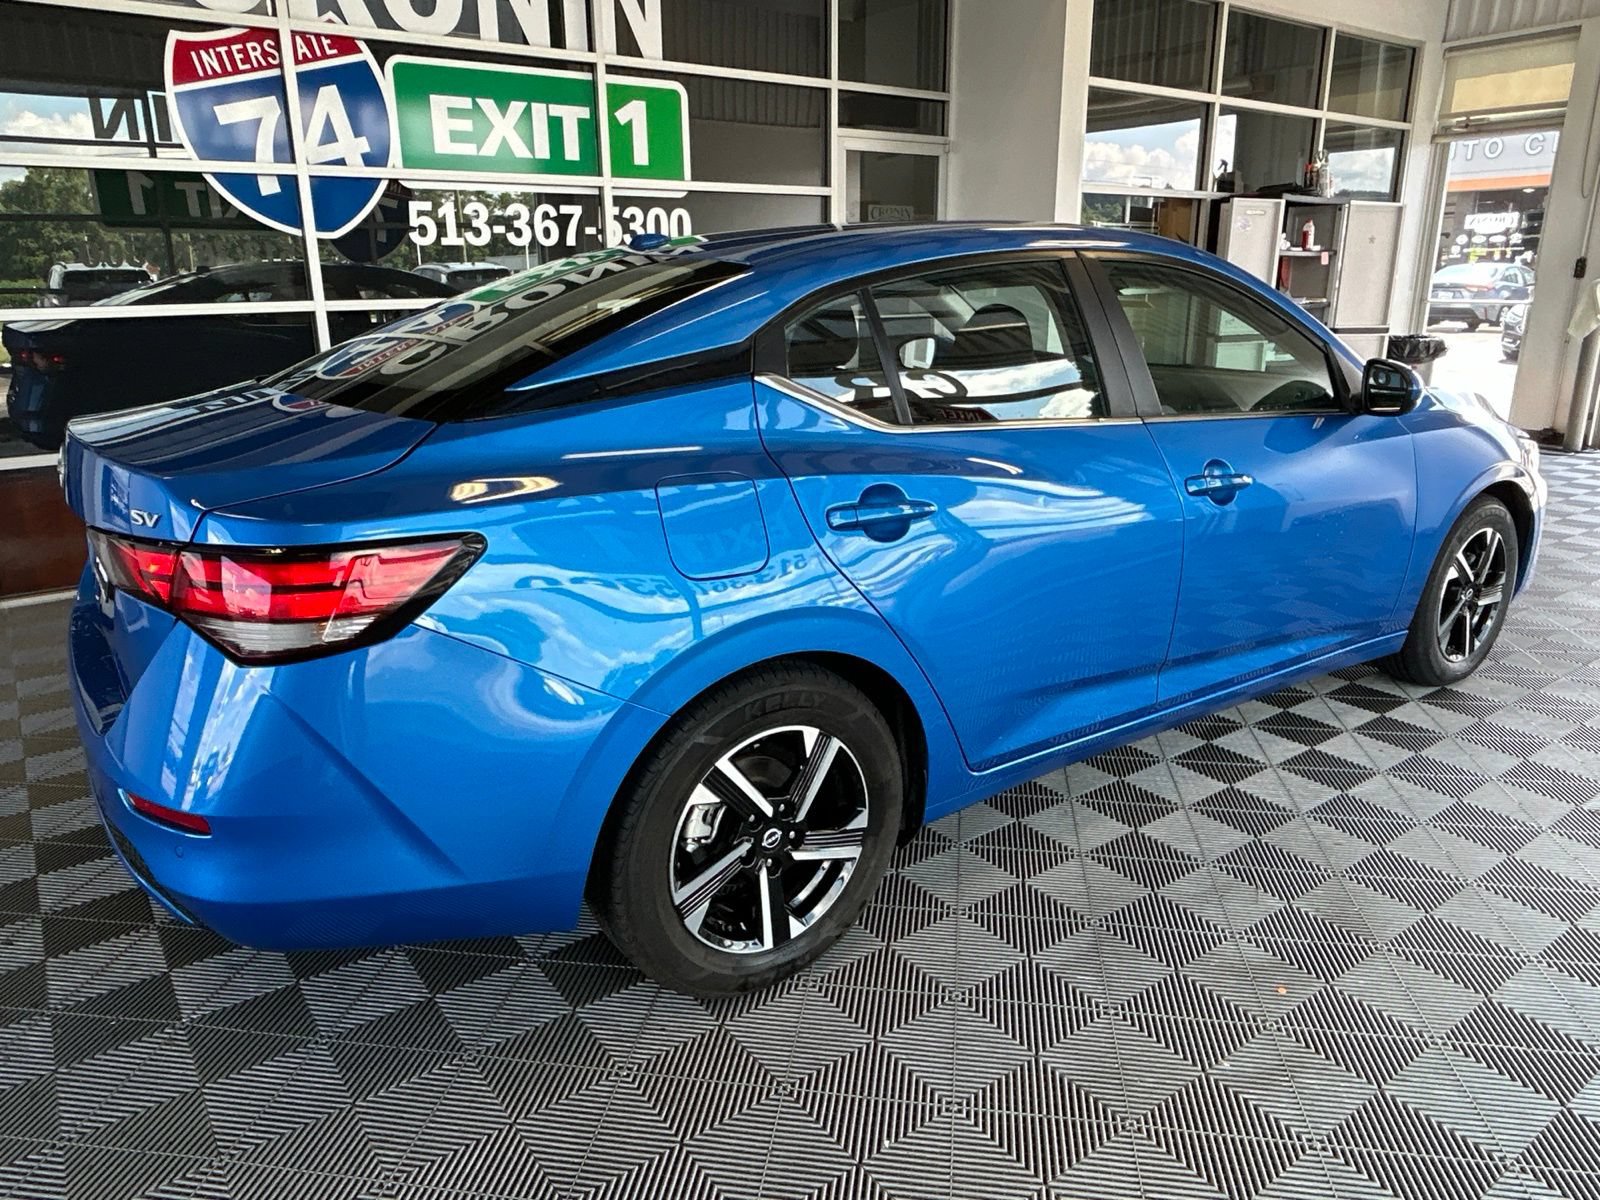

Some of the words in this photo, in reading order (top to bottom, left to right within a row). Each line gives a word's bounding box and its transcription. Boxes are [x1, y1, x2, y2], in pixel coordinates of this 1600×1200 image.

[192, 0, 664, 60] NIN
[190, 34, 338, 77] INTERSATE
[213, 84, 371, 197] 74
[429, 94, 590, 161] EXIT
[614, 100, 650, 166] 1
[408, 201, 692, 247] 513-367-5300
[869, 206, 912, 220] CRONIN
[131, 510, 159, 528] SV
[744, 690, 827, 720] KELLY
